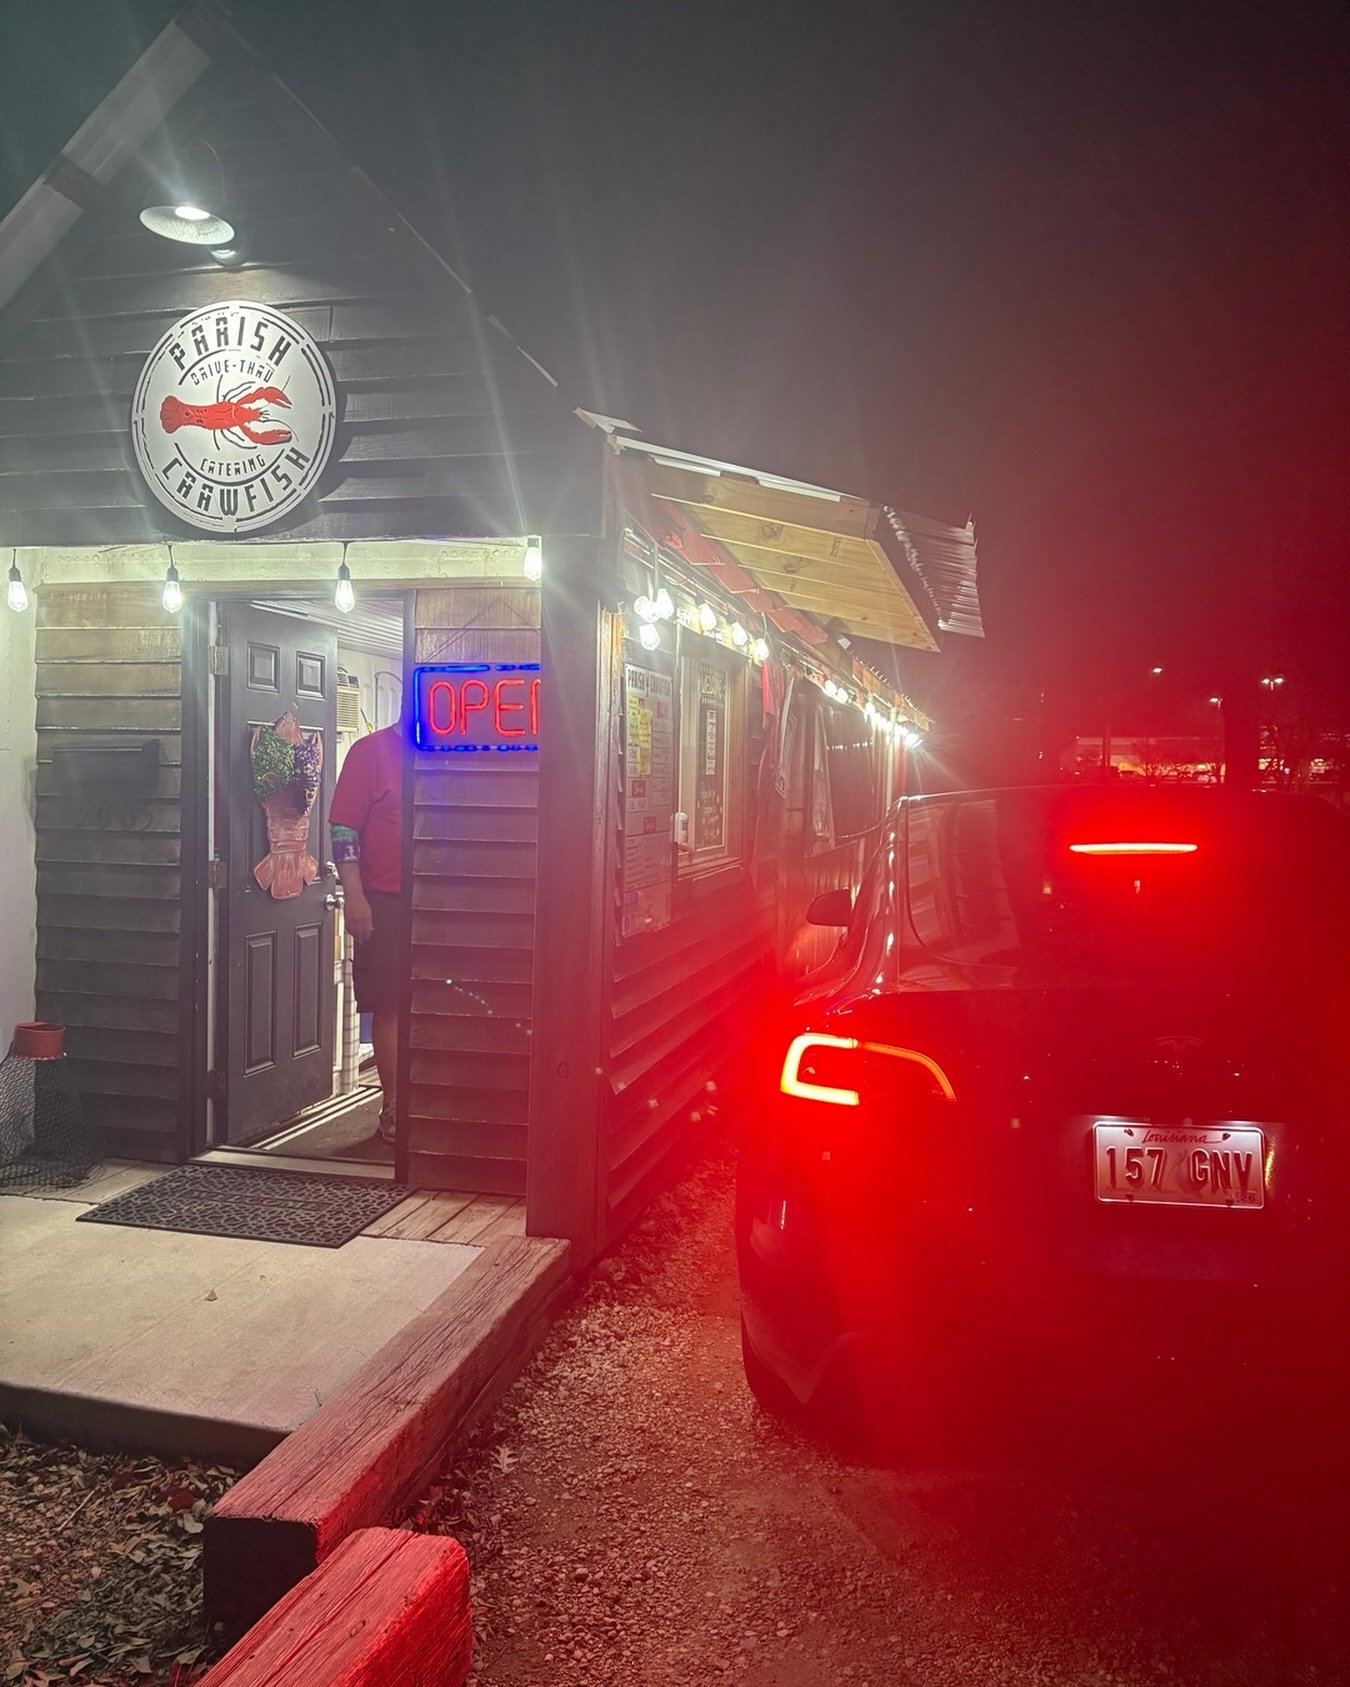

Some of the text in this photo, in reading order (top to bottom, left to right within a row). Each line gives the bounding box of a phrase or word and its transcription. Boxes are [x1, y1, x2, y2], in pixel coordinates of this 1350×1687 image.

[169, 316, 292, 371] PARISH
[190, 359, 275, 386] DRIVE-THRU
[162, 447, 311, 517] CRAWFISH
[199, 453, 266, 478] CATERING
[1142, 1130, 1222, 1144] Louisiana
[1106, 1146, 1253, 1194] 157 GNV
